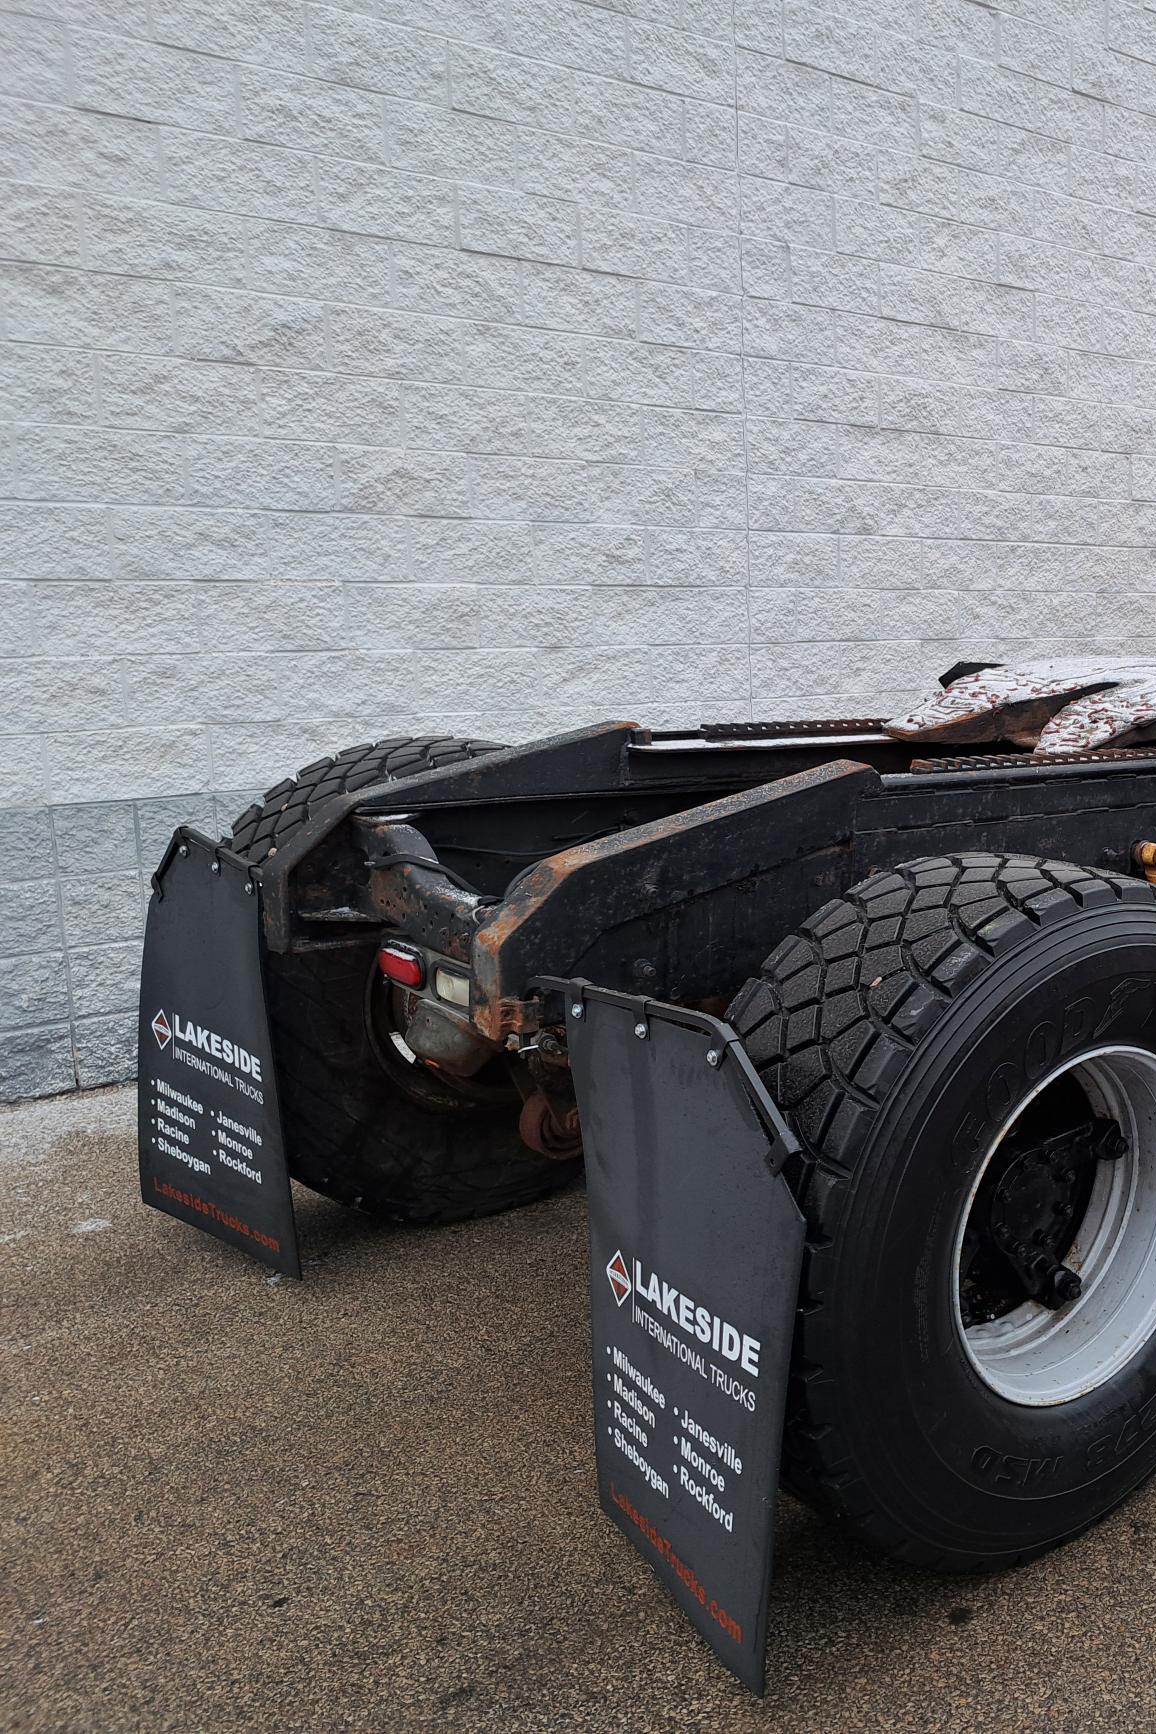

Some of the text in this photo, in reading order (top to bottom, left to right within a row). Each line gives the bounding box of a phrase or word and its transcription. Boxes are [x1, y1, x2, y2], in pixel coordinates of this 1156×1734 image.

[174, 1013, 263, 1083] LAKESIDE
[174, 1046, 265, 1106] INTERNATIONAL TRUCKS
[156, 1078, 204, 1115] Milwaukee
[157, 1097, 196, 1130] Madison
[157, 1117, 190, 1146] Racine
[157, 1137, 212, 1176] Sheboygan
[216, 1110, 263, 1147] Janesville
[217, 1129, 254, 1160] Monroe
[219, 1149, 262, 1185] Rockford
[152, 1175, 281, 1254] LakesideTrucks.com
[635, 1259, 761, 1378] LAKESIDE
[613, 1345, 666, 1409] Milwaukee
[635, 1305, 756, 1413] INTERNATIONAL TRUCKS
[613, 1373, 656, 1429] Madison
[613, 1400, 649, 1449] Racine
[614, 1427, 670, 1500] Sheboygan
[681, 1405, 743, 1476] Janesville
[681, 1436, 726, 1493] Monroe
[680, 1465, 734, 1533] Rockford
